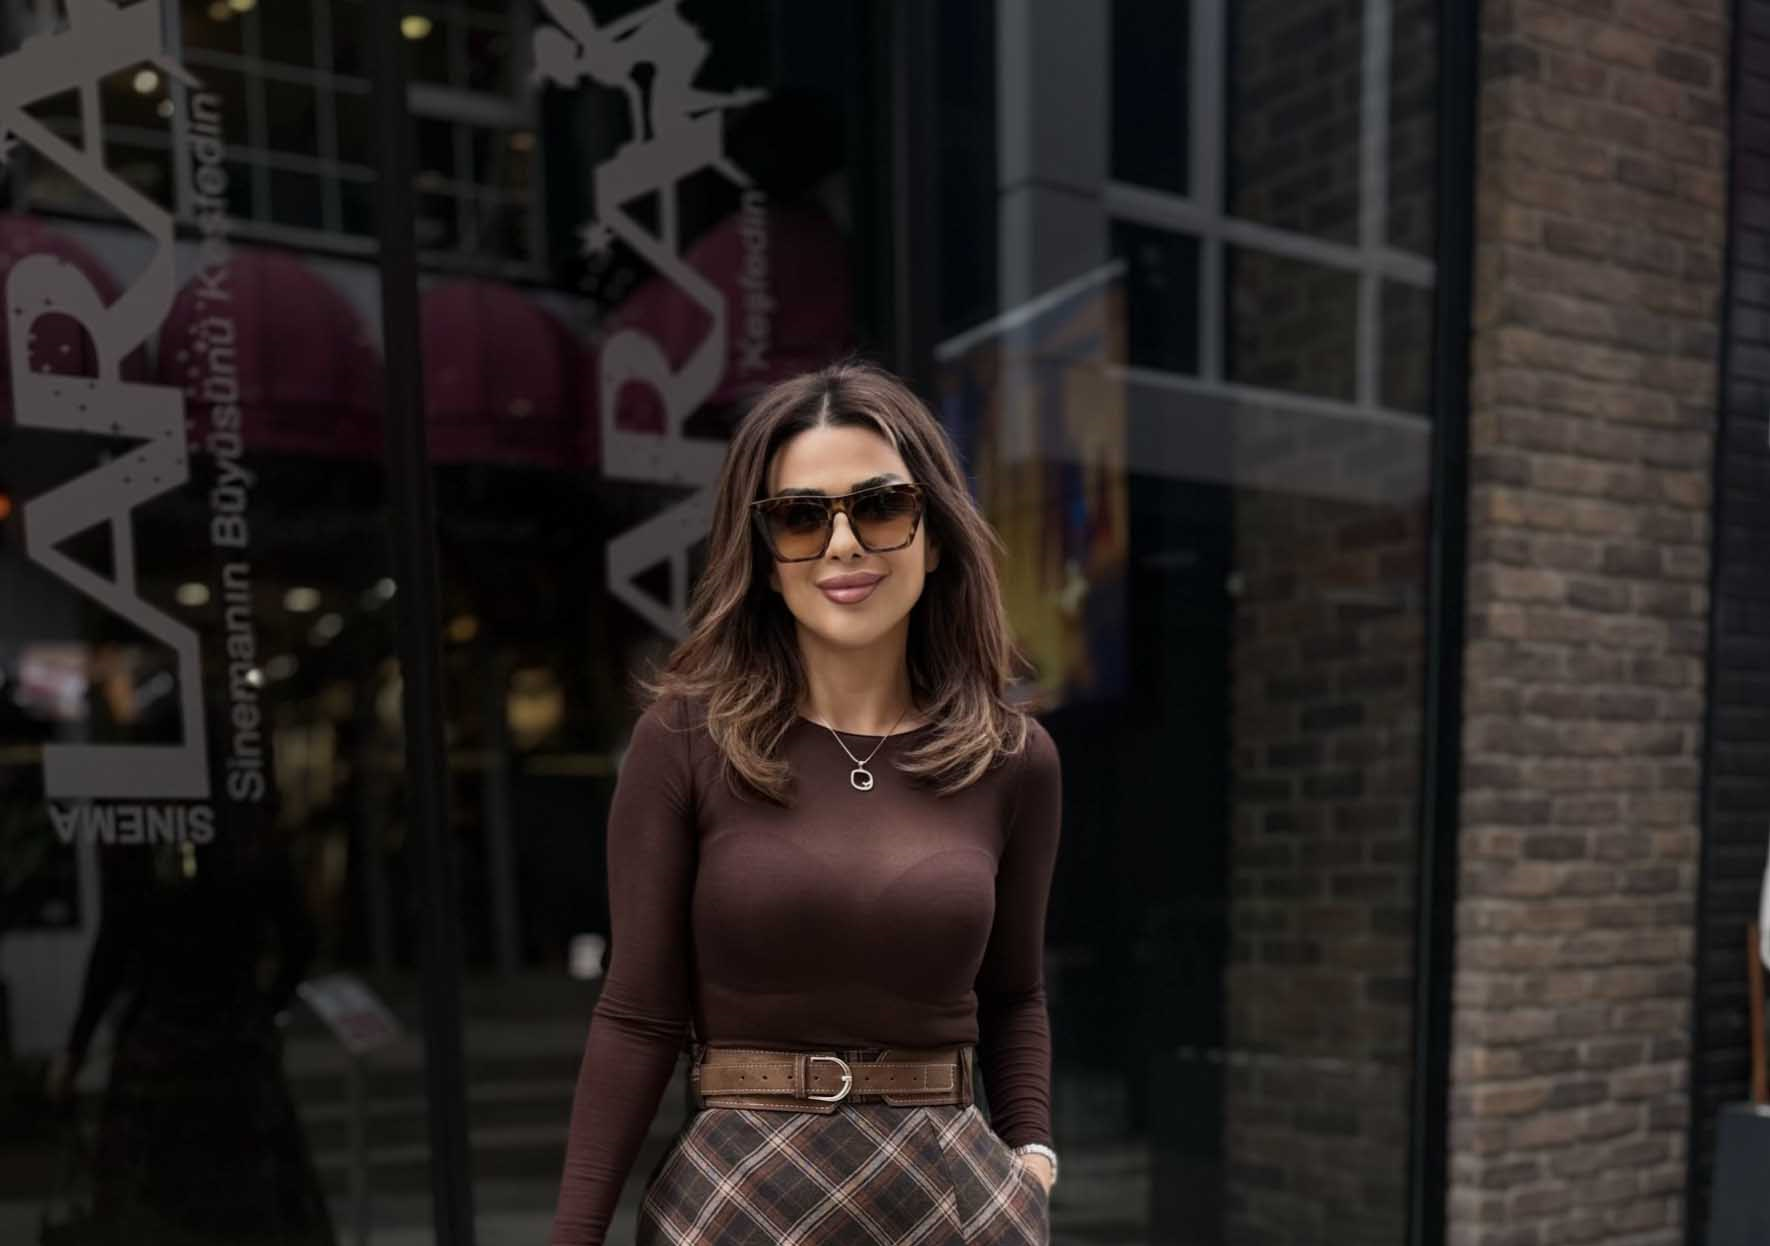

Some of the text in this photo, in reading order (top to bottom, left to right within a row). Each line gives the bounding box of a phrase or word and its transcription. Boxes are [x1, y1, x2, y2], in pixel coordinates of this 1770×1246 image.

[0, 2, 210, 799] LARA
[192, 316, 257, 549] Büyüsünü
[596, 105, 732, 646] ARA
[222, 561, 266, 801] Sinemanın
